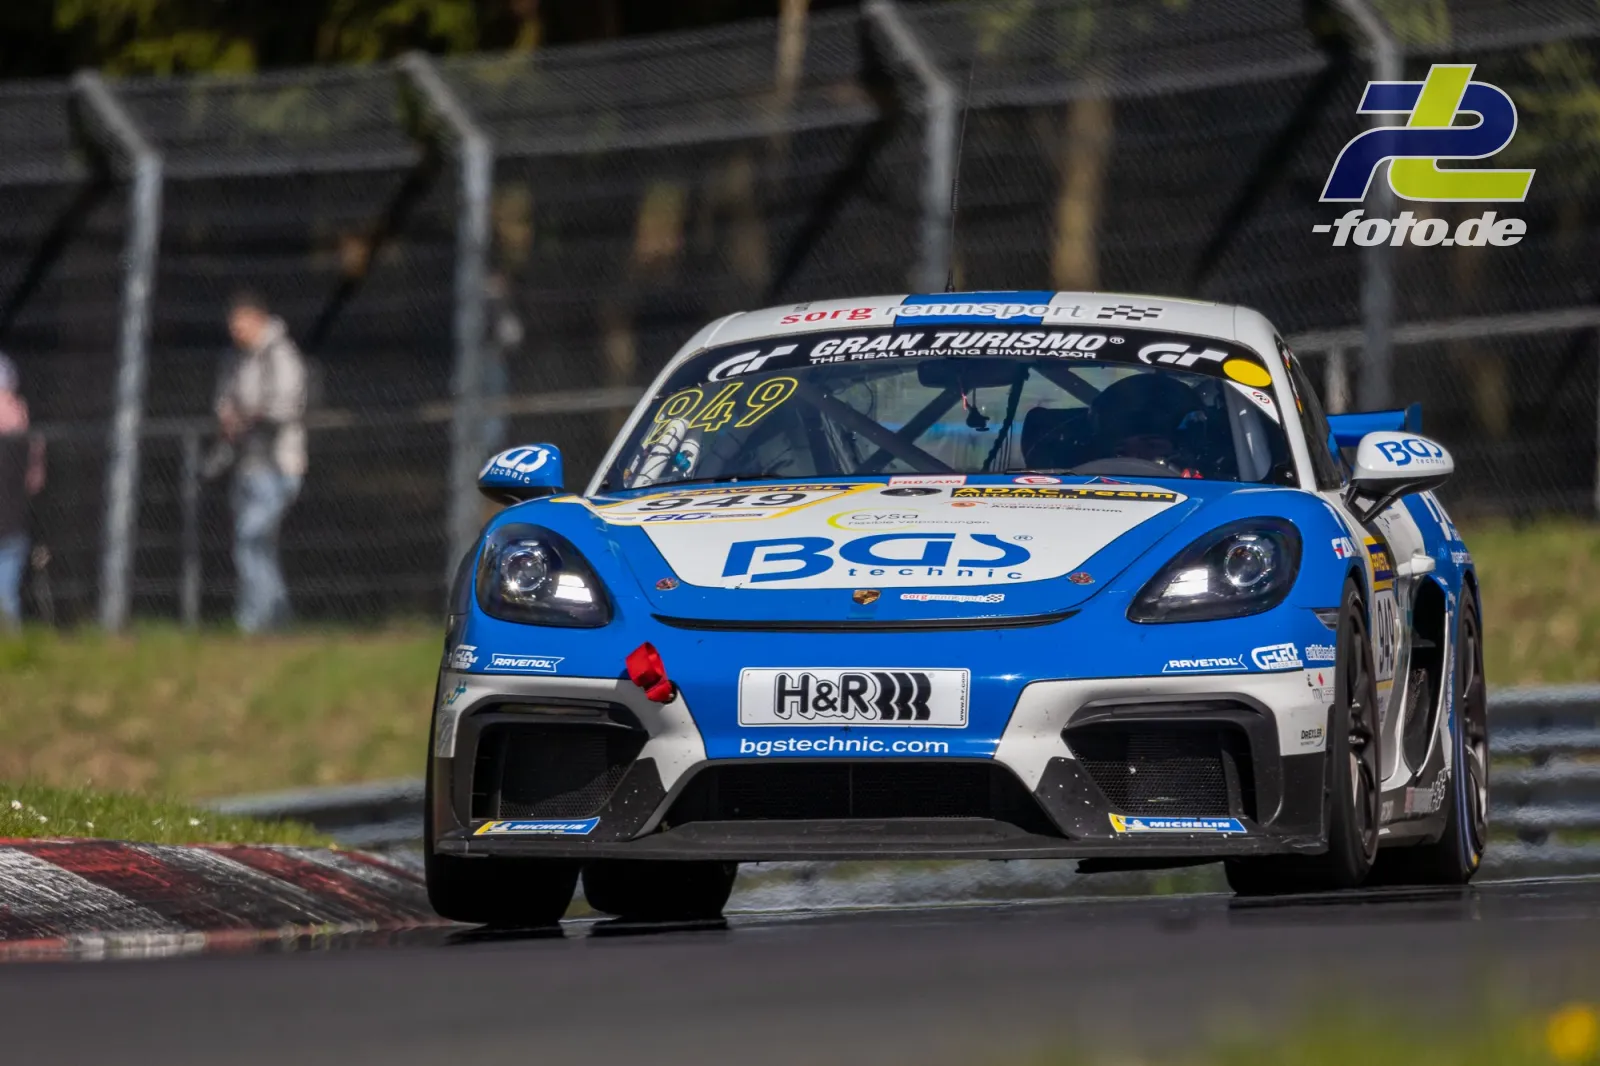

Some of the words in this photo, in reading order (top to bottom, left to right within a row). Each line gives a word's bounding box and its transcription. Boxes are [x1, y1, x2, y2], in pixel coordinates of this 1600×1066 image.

[781, 307, 877, 325] sorg
[885, 303, 1082, 319] rennsport
[809, 333, 924, 358] GRAN
[810, 355, 845, 365] THE
[851, 351, 899, 361] REAL
[903, 348, 981, 357] DRIVING
[986, 348, 1097, 360] SIMULATOR
[642, 377, 798, 449] 949
[490, 467, 531, 484] technic
[955, 487, 1061, 495] ADAC
[1073, 488, 1174, 499] Team
[637, 493, 807, 512] 949
[848, 567, 1023, 580] technic
[903, 594, 928, 602] sorg
[494, 657, 553, 668] RAVENOL
[1169, 658, 1239, 668] RAVENOL
[774, 673, 876, 720] H&R
[740, 736, 949, 756] bgstechnic.com
